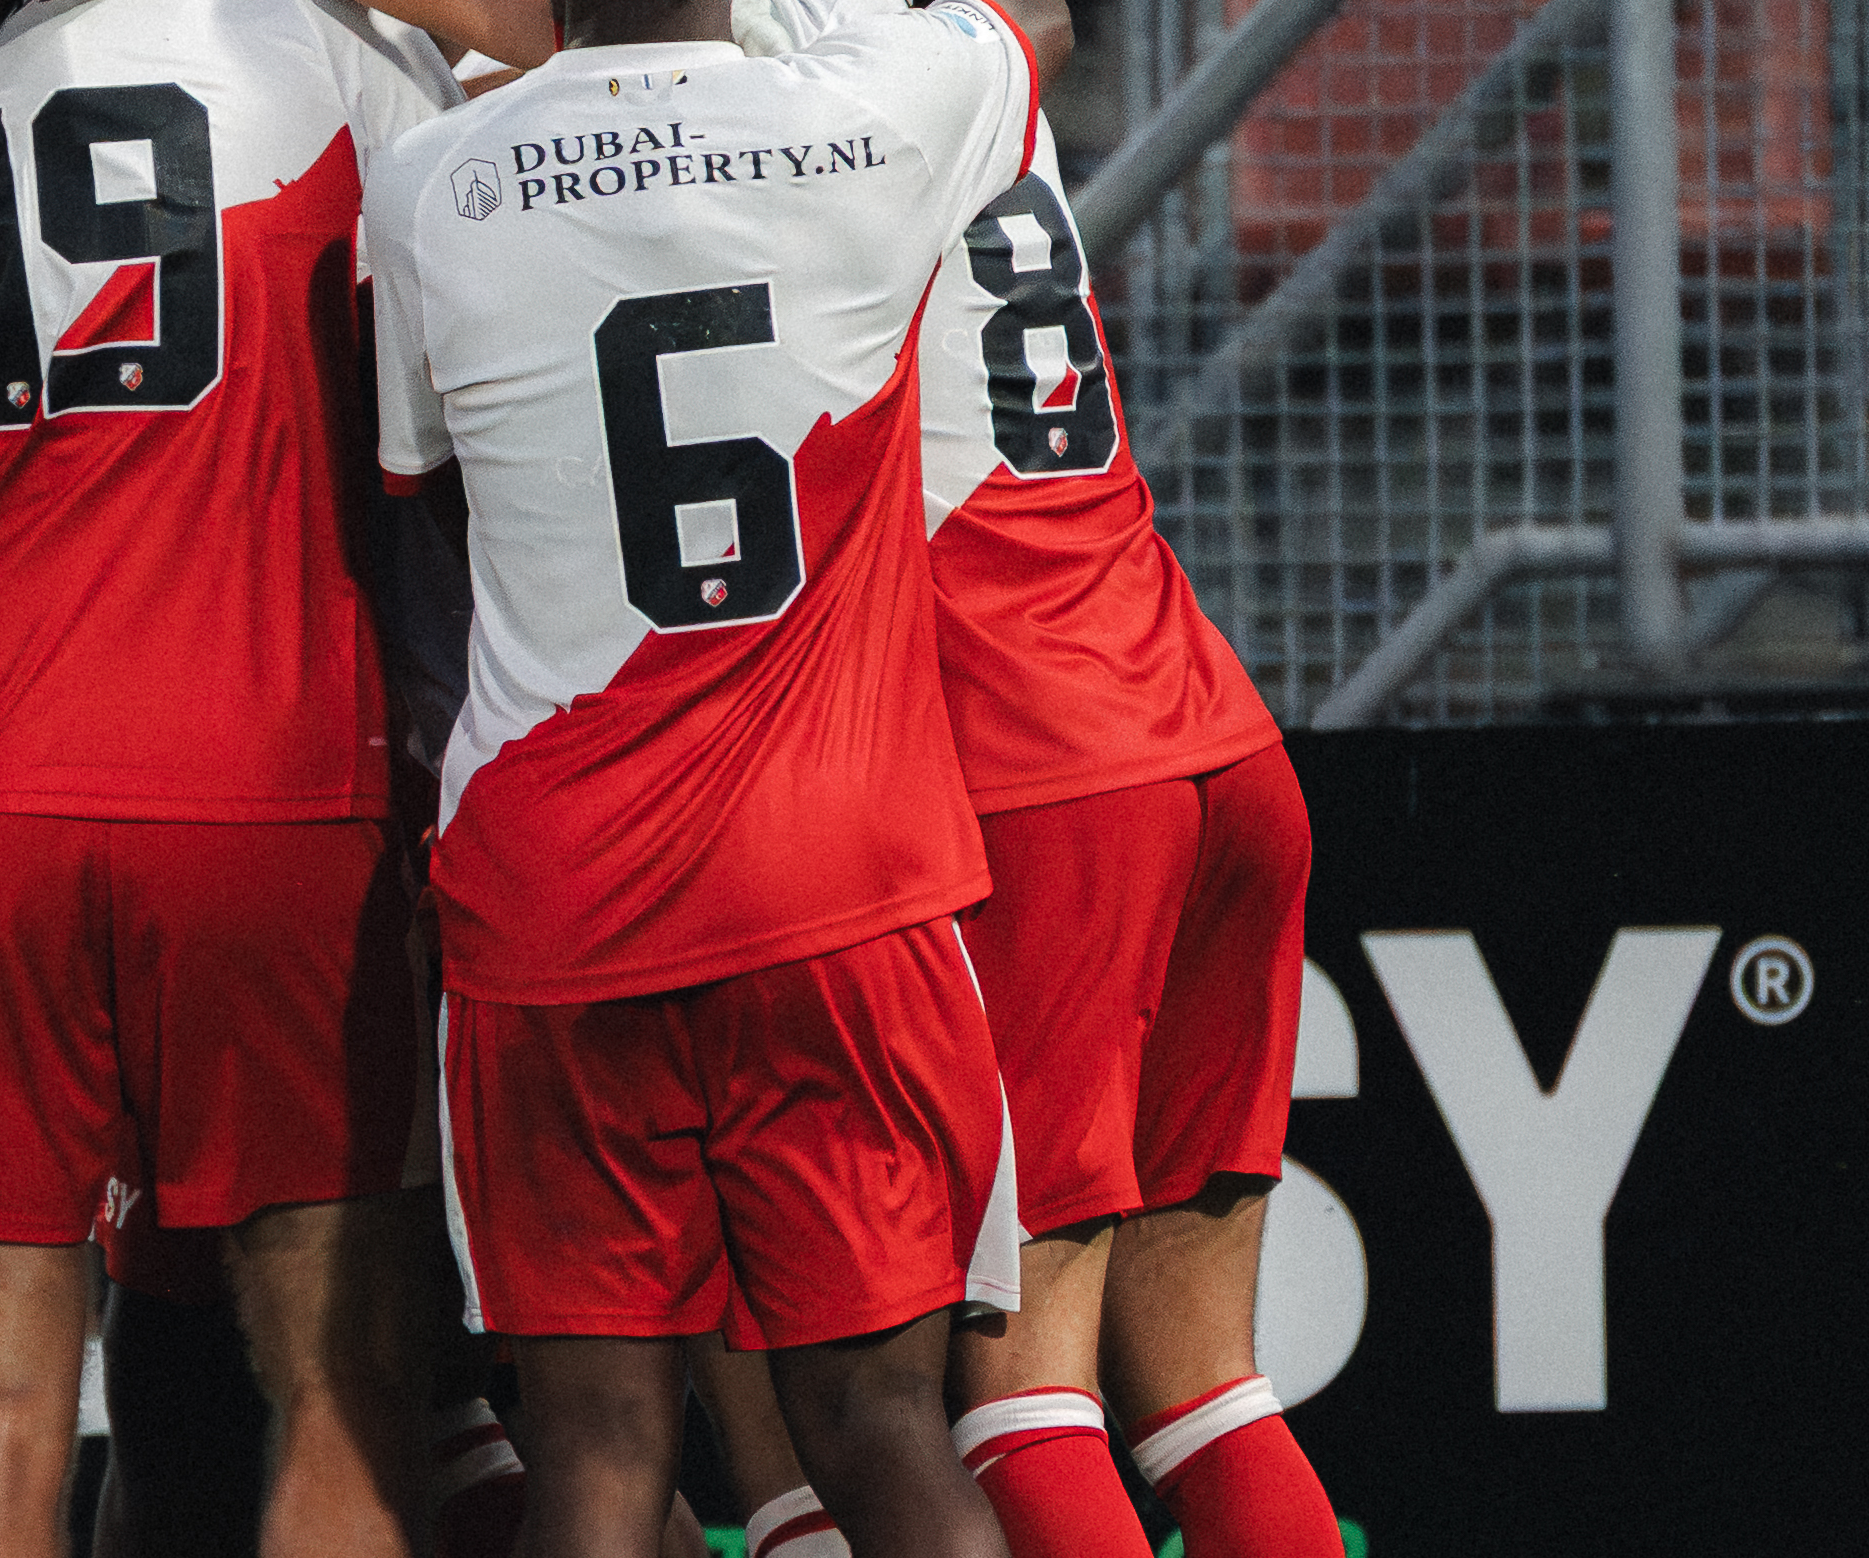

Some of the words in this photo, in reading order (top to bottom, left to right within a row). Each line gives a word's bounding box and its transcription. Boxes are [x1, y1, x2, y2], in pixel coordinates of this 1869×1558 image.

[511, 122, 706, 175] DUBAI-
[520, 136, 886, 212] PROPERTY.NL
[964, 170, 1120, 480] 8
[591, 278, 806, 635] 6
